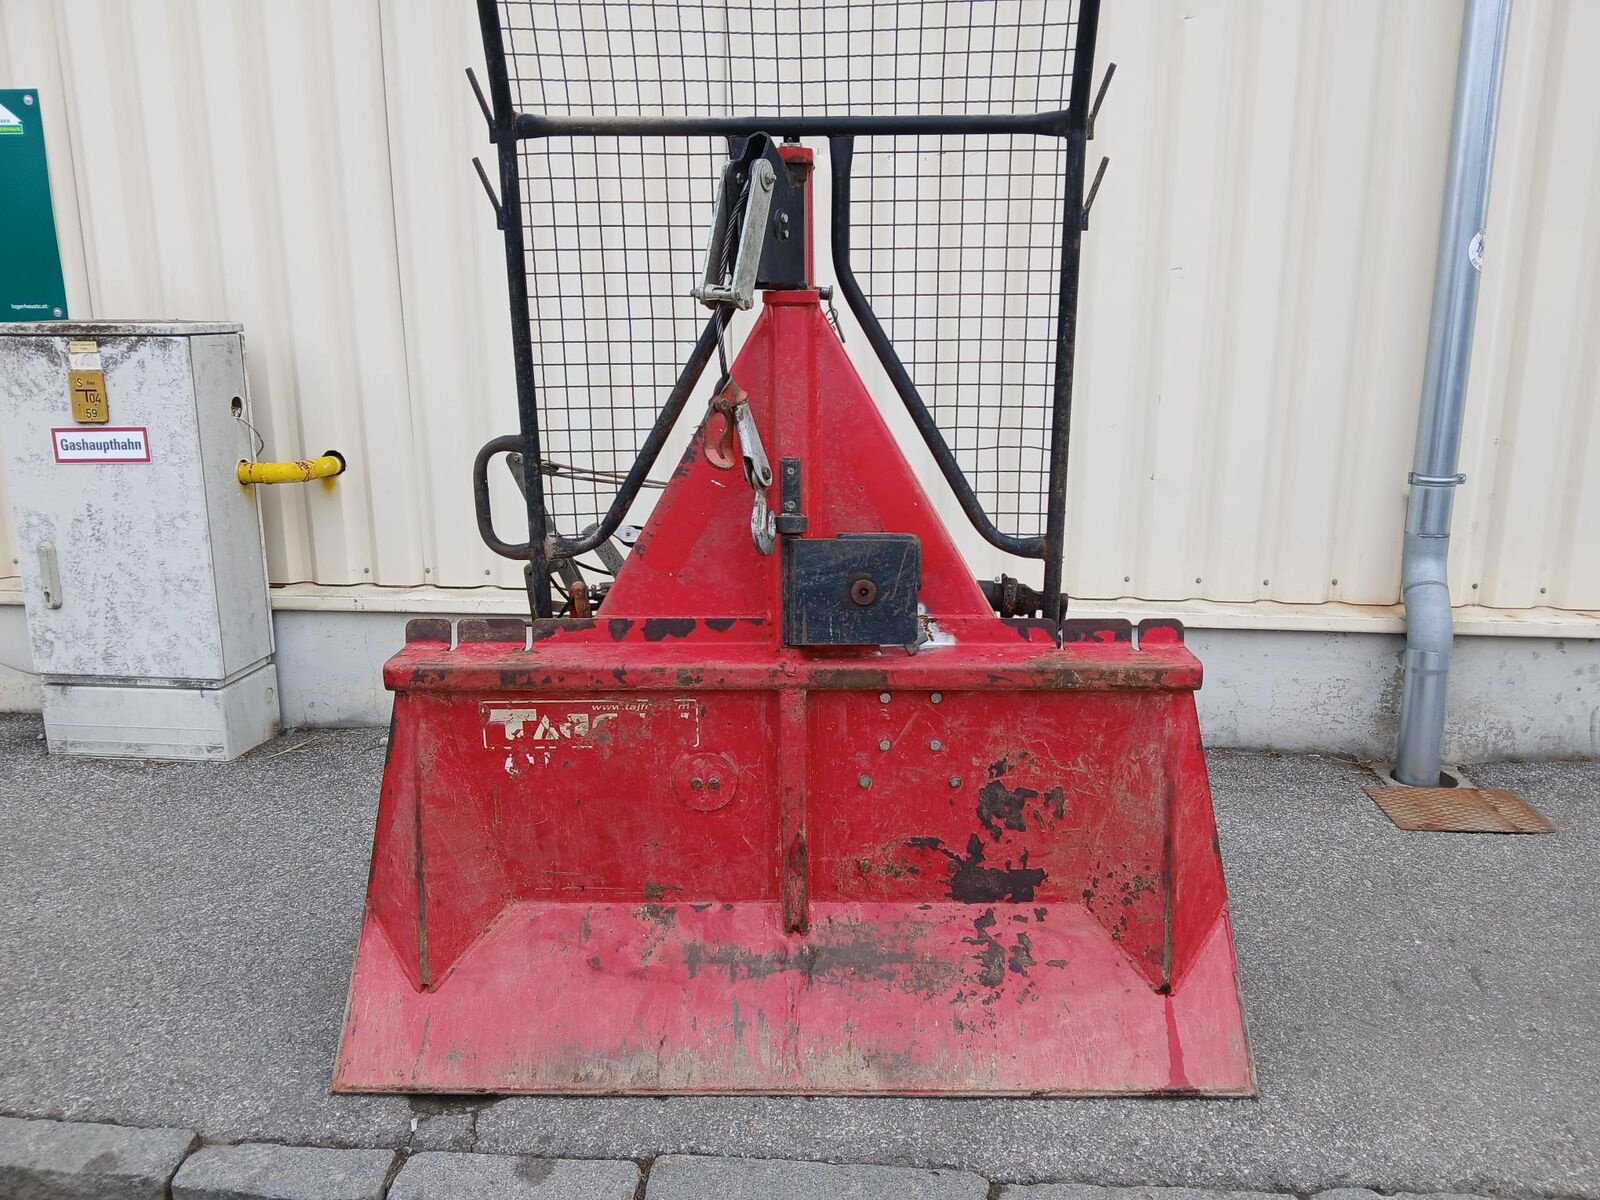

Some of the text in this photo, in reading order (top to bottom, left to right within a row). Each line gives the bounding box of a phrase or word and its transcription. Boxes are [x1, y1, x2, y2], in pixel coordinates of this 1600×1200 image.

[76, 377, 83, 388] S
[85, 408, 98, 419] 59
[60, 438, 142, 454] Gashaupthahn
